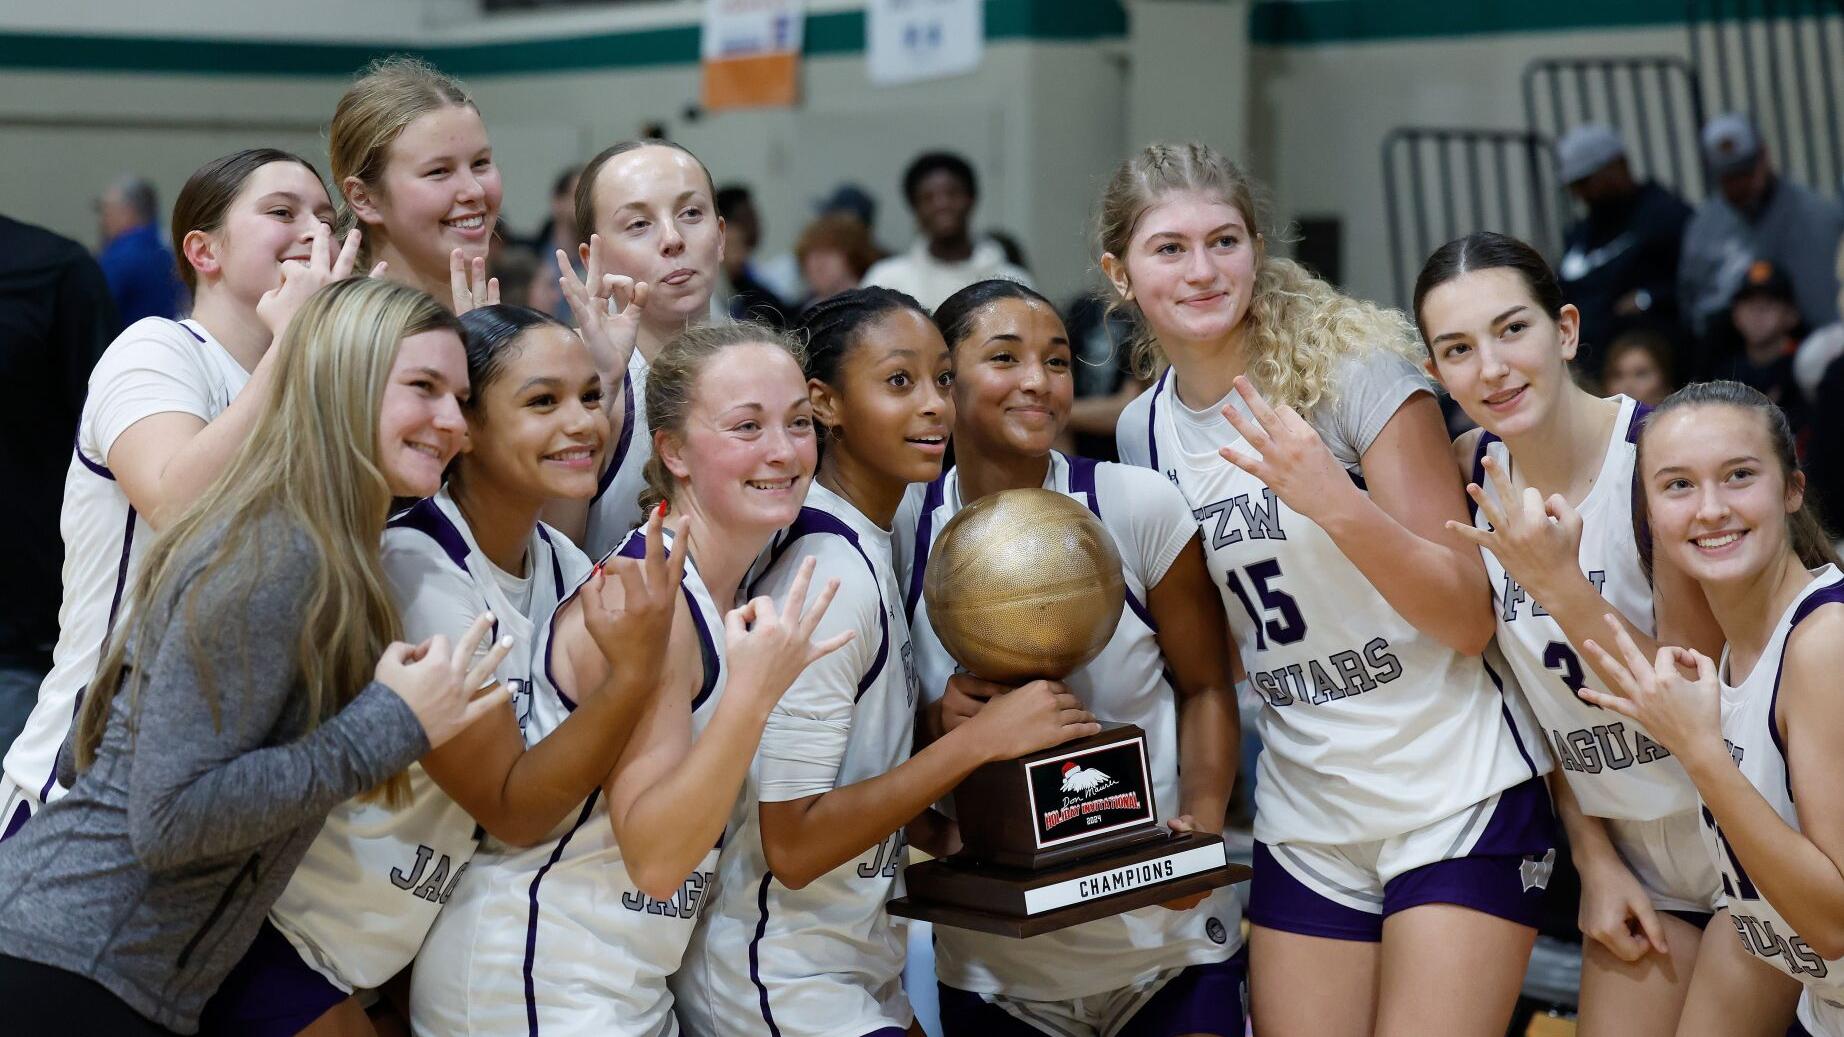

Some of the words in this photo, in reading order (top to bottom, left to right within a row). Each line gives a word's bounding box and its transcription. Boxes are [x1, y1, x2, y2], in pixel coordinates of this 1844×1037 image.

[1226, 557, 1308, 652] 15
[1044, 804, 1080, 831] HOLIDAY
[1081, 790, 1141, 815] INVITATIONAL
[1062, 796, 1084, 809] Don
[1086, 814, 1102, 826] 2024
[1079, 859, 1173, 898] CHAMPIONS
